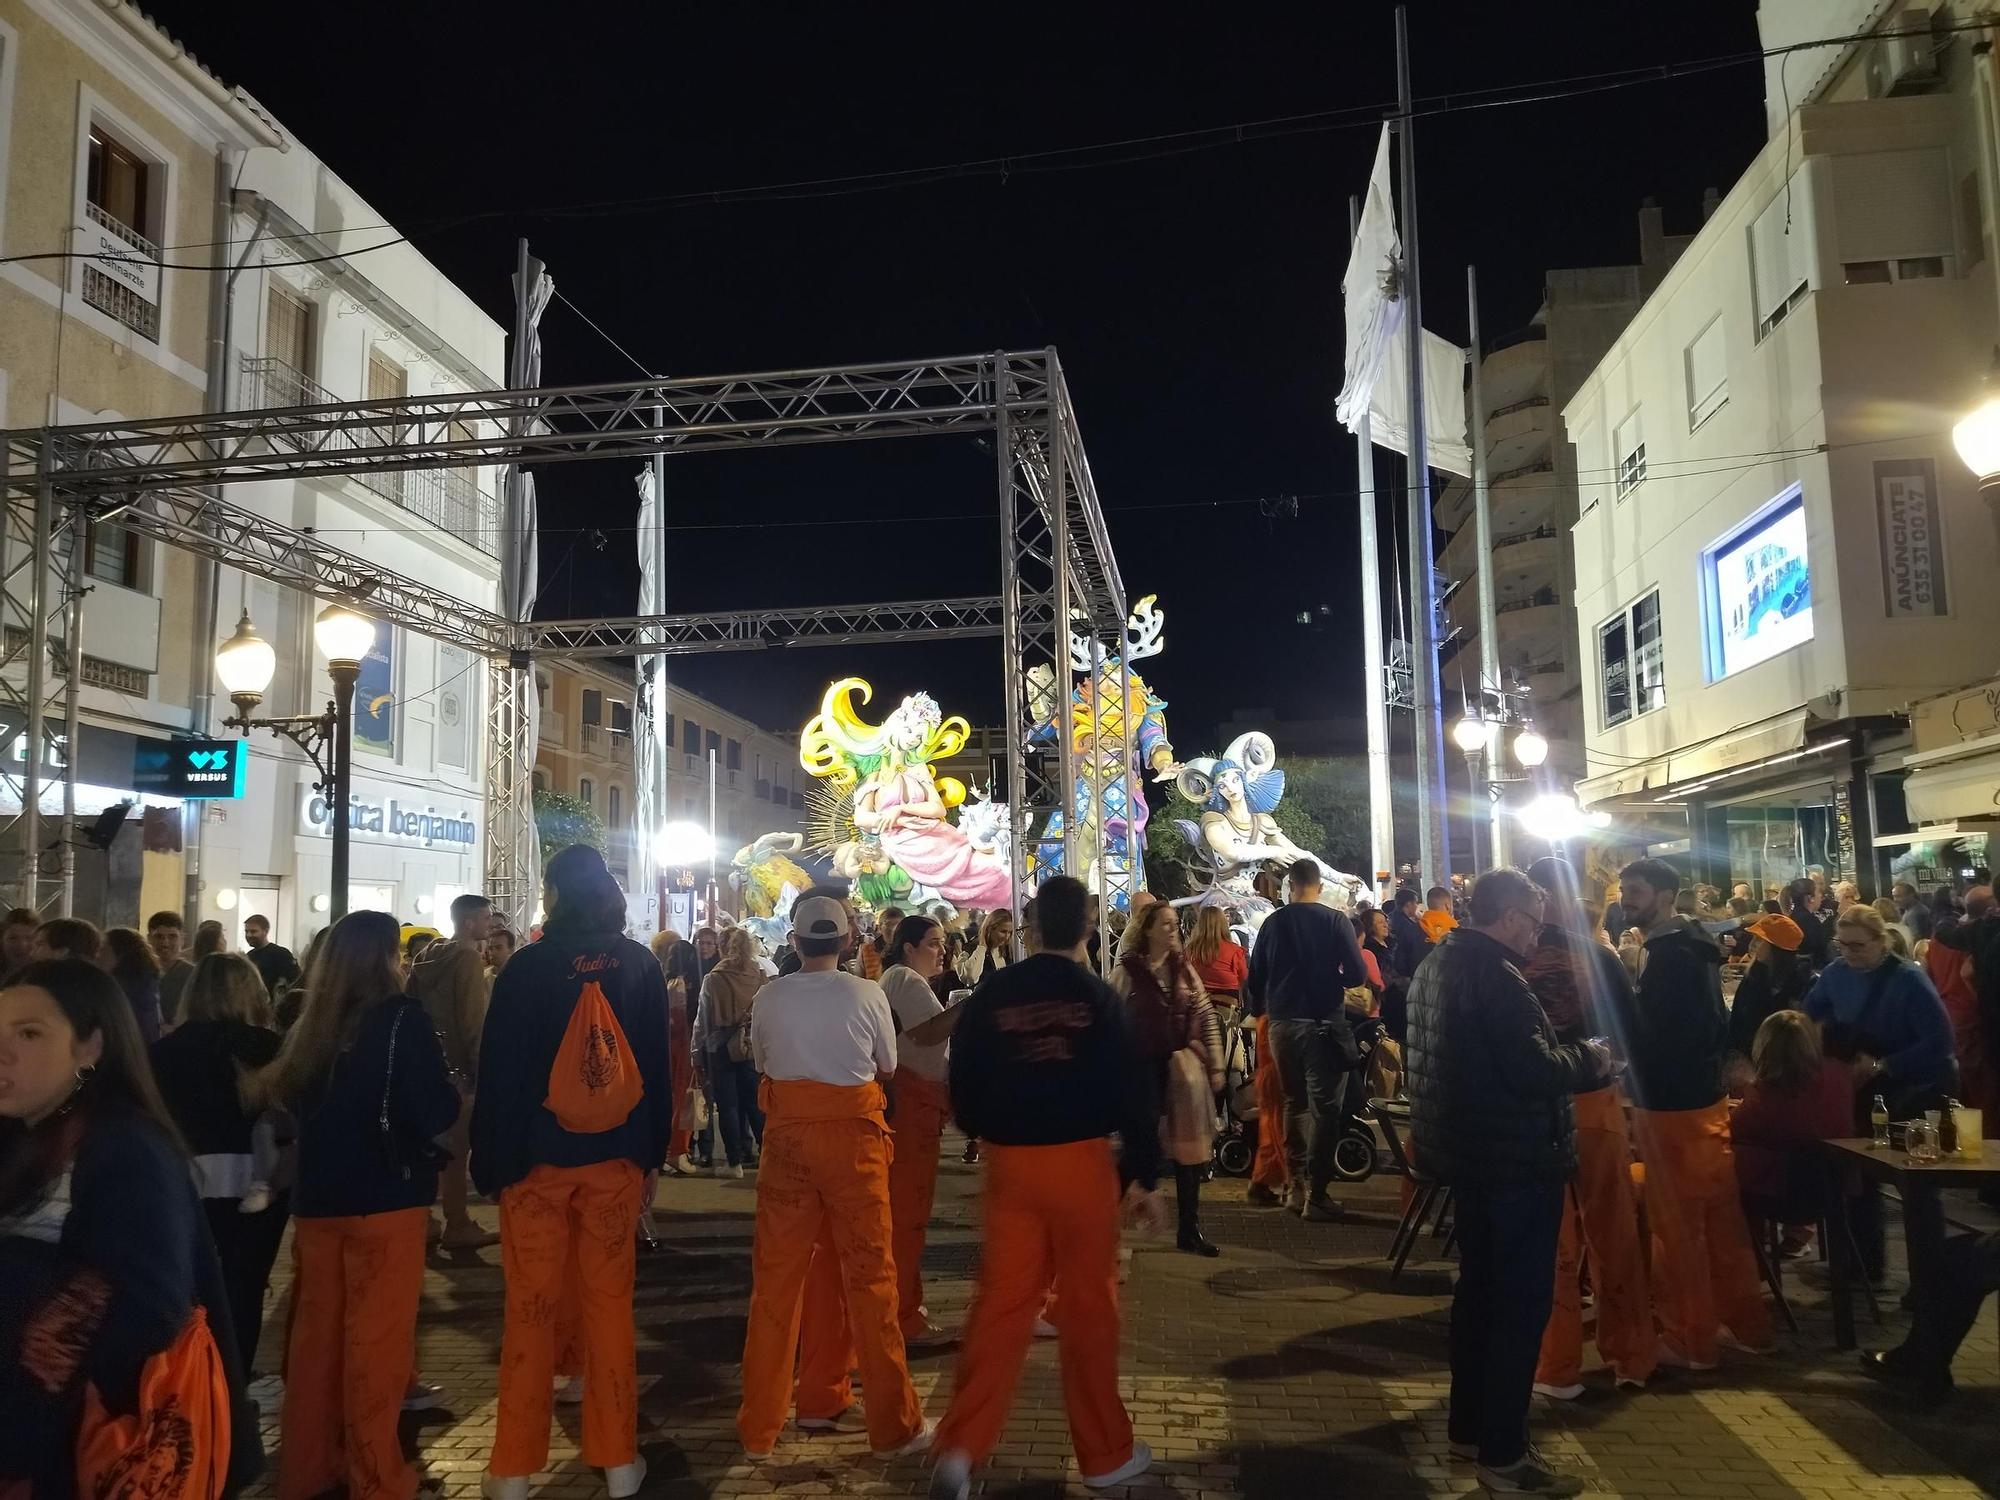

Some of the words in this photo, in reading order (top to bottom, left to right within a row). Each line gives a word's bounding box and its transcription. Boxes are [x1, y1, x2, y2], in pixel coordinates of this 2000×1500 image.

[100, 236, 145, 274] Deutsche
[1889, 482, 1913, 611] ANÚNCIATE
[187, 773, 228, 782] VERSUS
[309, 789, 384, 835] ópica
[389, 799, 475, 847] benjamín
[647, 898, 685, 914] Plu
